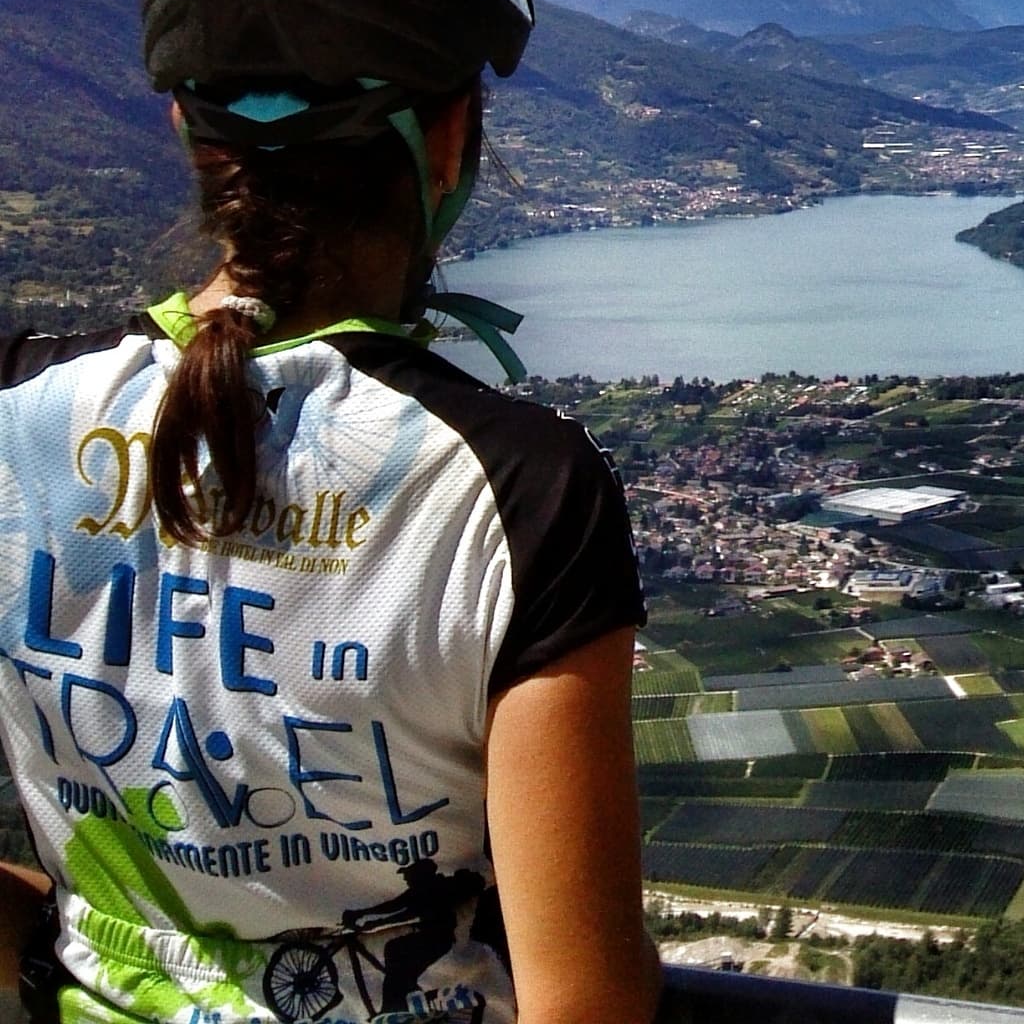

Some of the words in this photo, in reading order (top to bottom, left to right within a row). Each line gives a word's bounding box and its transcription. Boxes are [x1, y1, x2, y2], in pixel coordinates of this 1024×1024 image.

[300, 556, 316, 573] DI
[317, 559, 349, 575] NON
[24, 549, 278, 696] LIFE
[321, 830, 439, 866] VIAGGIO
